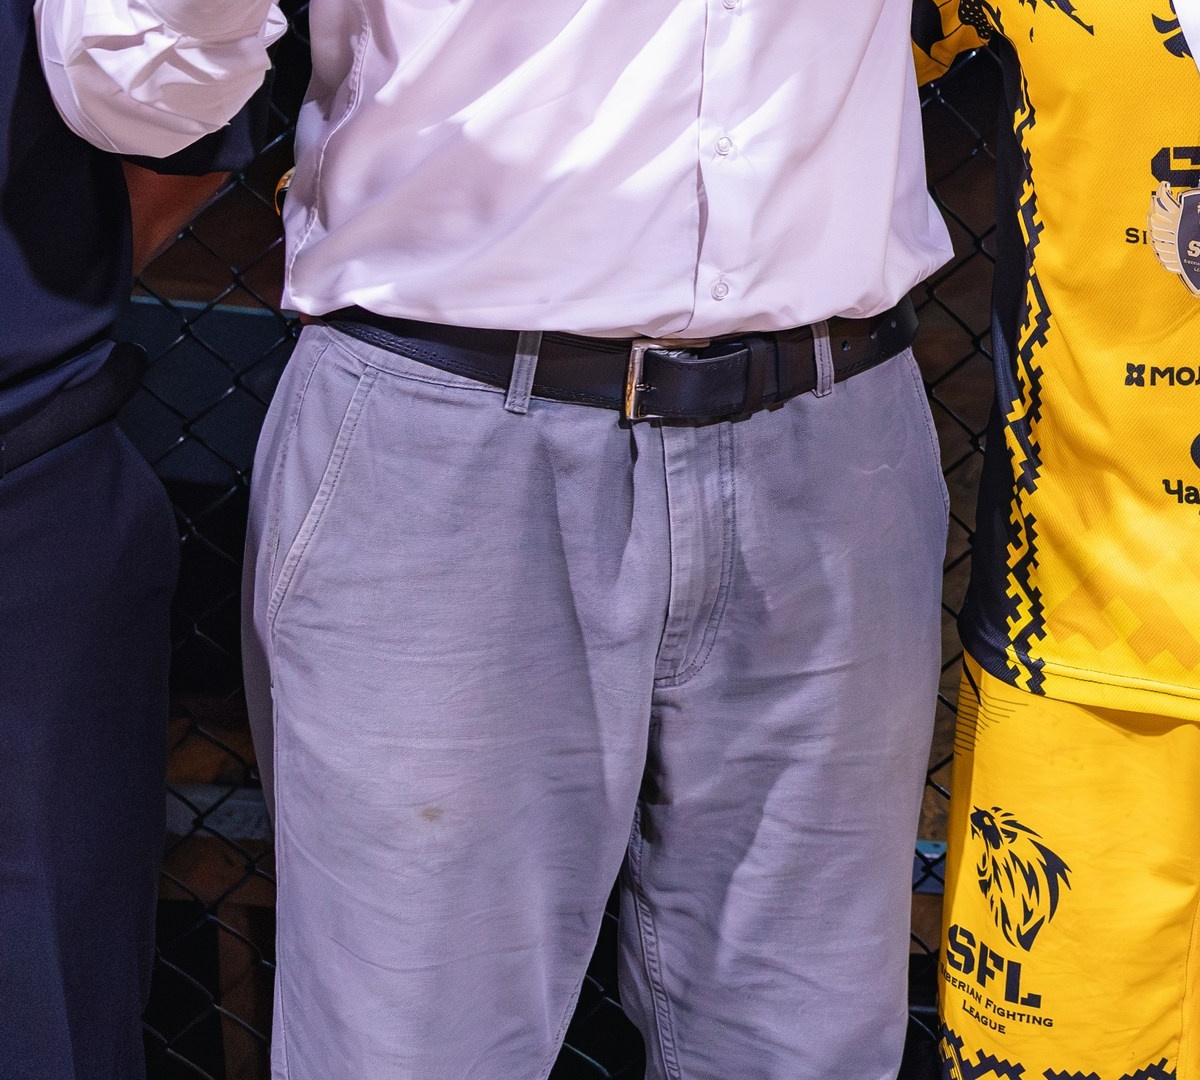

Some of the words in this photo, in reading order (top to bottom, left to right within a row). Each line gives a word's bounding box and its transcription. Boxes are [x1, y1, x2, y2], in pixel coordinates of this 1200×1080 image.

[946, 924, 1041, 1008] SFL
[962, 999, 1006, 1034] LEAGUE
[985, 998, 1054, 1027] FIGHTING
